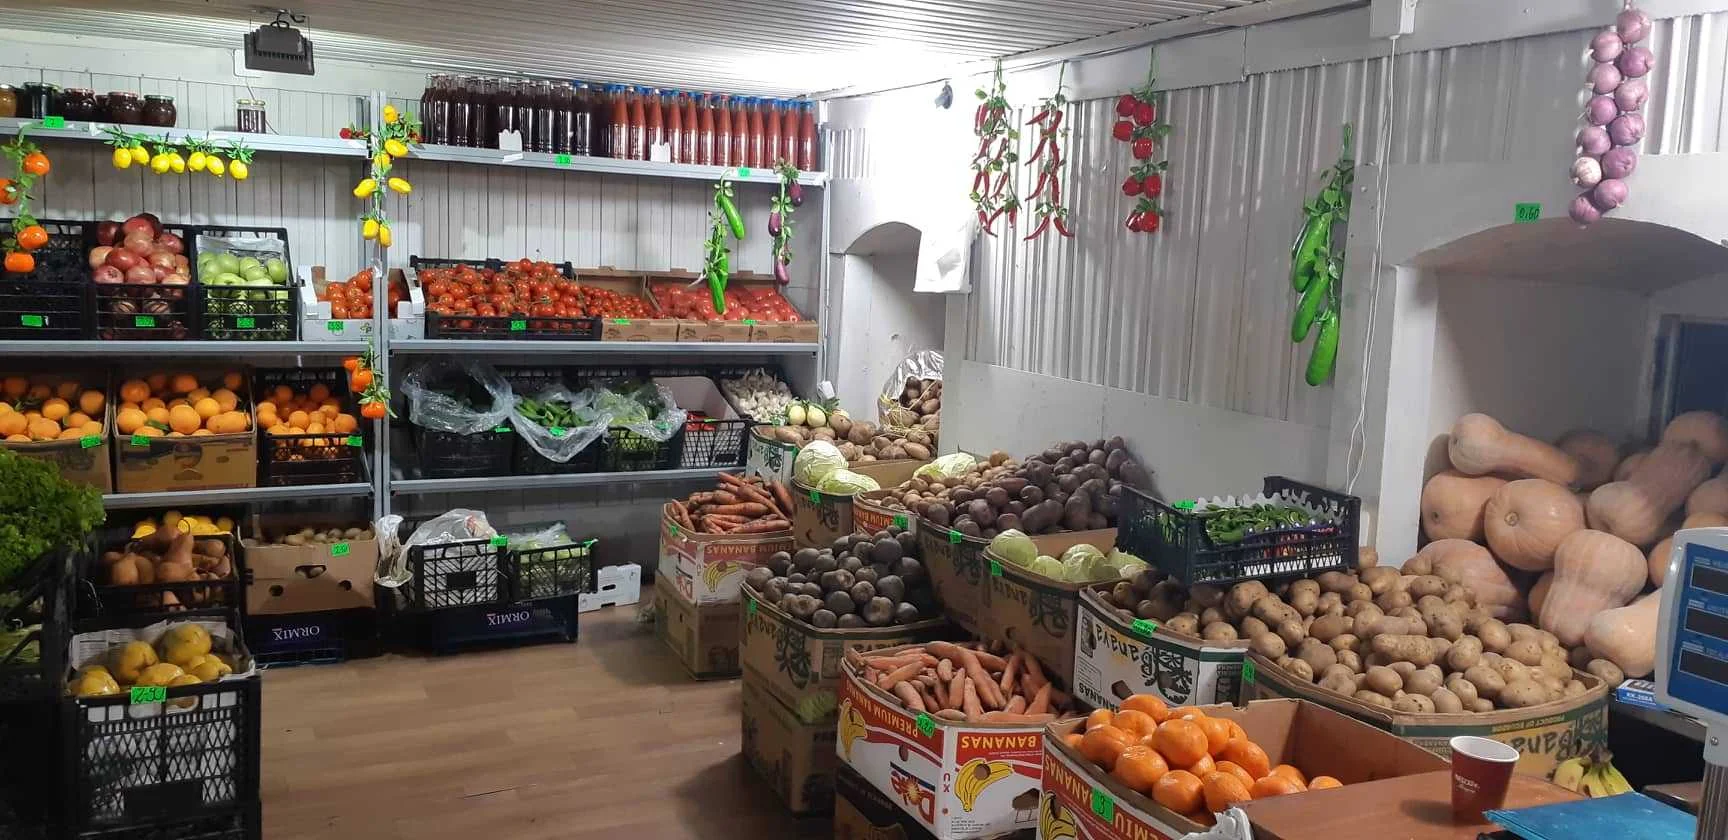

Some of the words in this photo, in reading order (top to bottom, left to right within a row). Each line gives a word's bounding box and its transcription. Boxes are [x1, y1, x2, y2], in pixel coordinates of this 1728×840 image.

[706, 544, 756, 555] BANANAS
[487, 611, 530, 626] ORMIX
[272, 625, 320, 641] ORMIX
[873, 705, 918, 738] PREMIUM
[961, 735, 1037, 749] BANANAS
[1506, 731, 1575, 762] Bana
[1044, 754, 1093, 804] ANANAS
